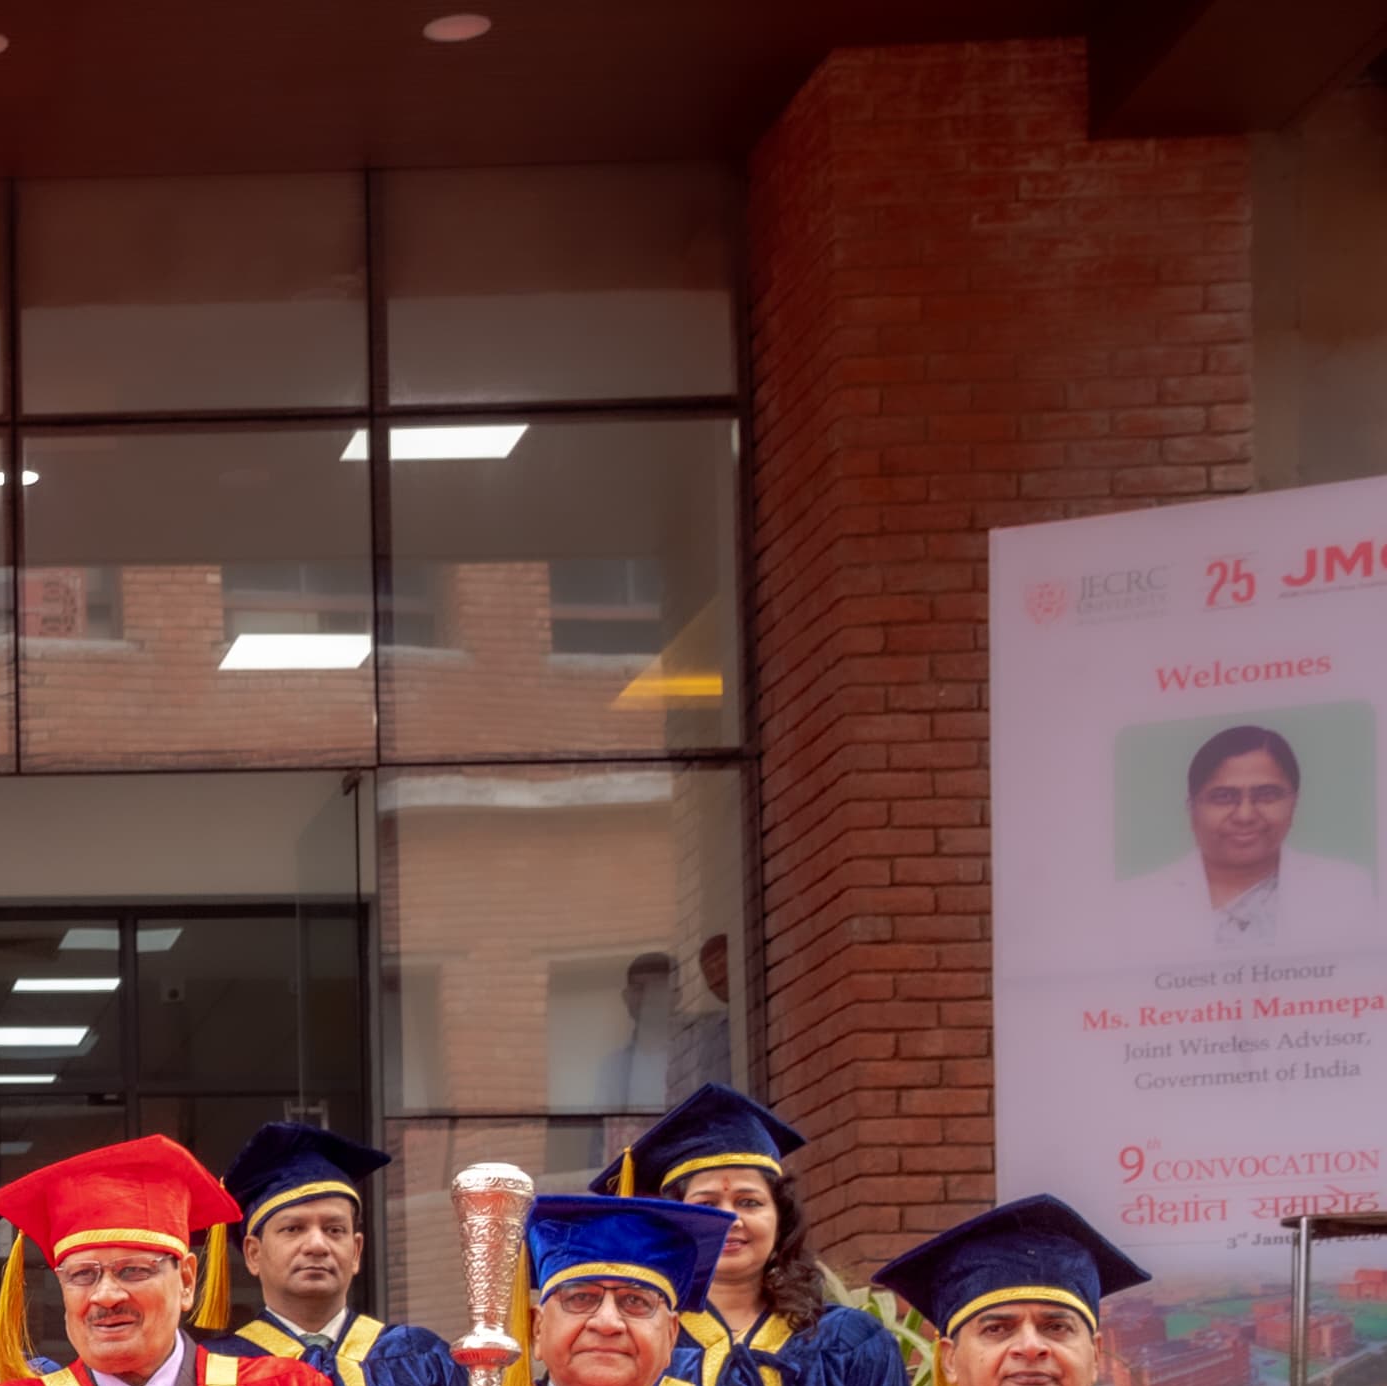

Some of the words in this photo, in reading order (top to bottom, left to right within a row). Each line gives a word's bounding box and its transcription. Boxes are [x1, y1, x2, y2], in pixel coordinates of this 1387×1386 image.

[1282, 541, 1387, 588] JM
[1079, 566, 1169, 600] JECRC
[1204, 559, 1256, 607] 25
[1155, 655, 1333, 693] Welcomes
[1154, 970, 1216, 991] Guest
[1222, 965, 1245, 985] of
[1250, 961, 1336, 984] Honour
[1082, 1009, 1130, 1032] Ms.
[1138, 999, 1243, 1028] Revathi
[1123, 1039, 1173, 1064] Joint
[1178, 1032, 1270, 1057] Wireless
[1275, 1028, 1372, 1051] Advisor,
[1134, 1066, 1269, 1091] Government
[1275, 1062, 1299, 1083] of
[1303, 1058, 1362, 1081] India
[1152, 1149, 1381, 1183] CONVOCATION
[1120, 1193, 1230, 1226] दीक्षांत
